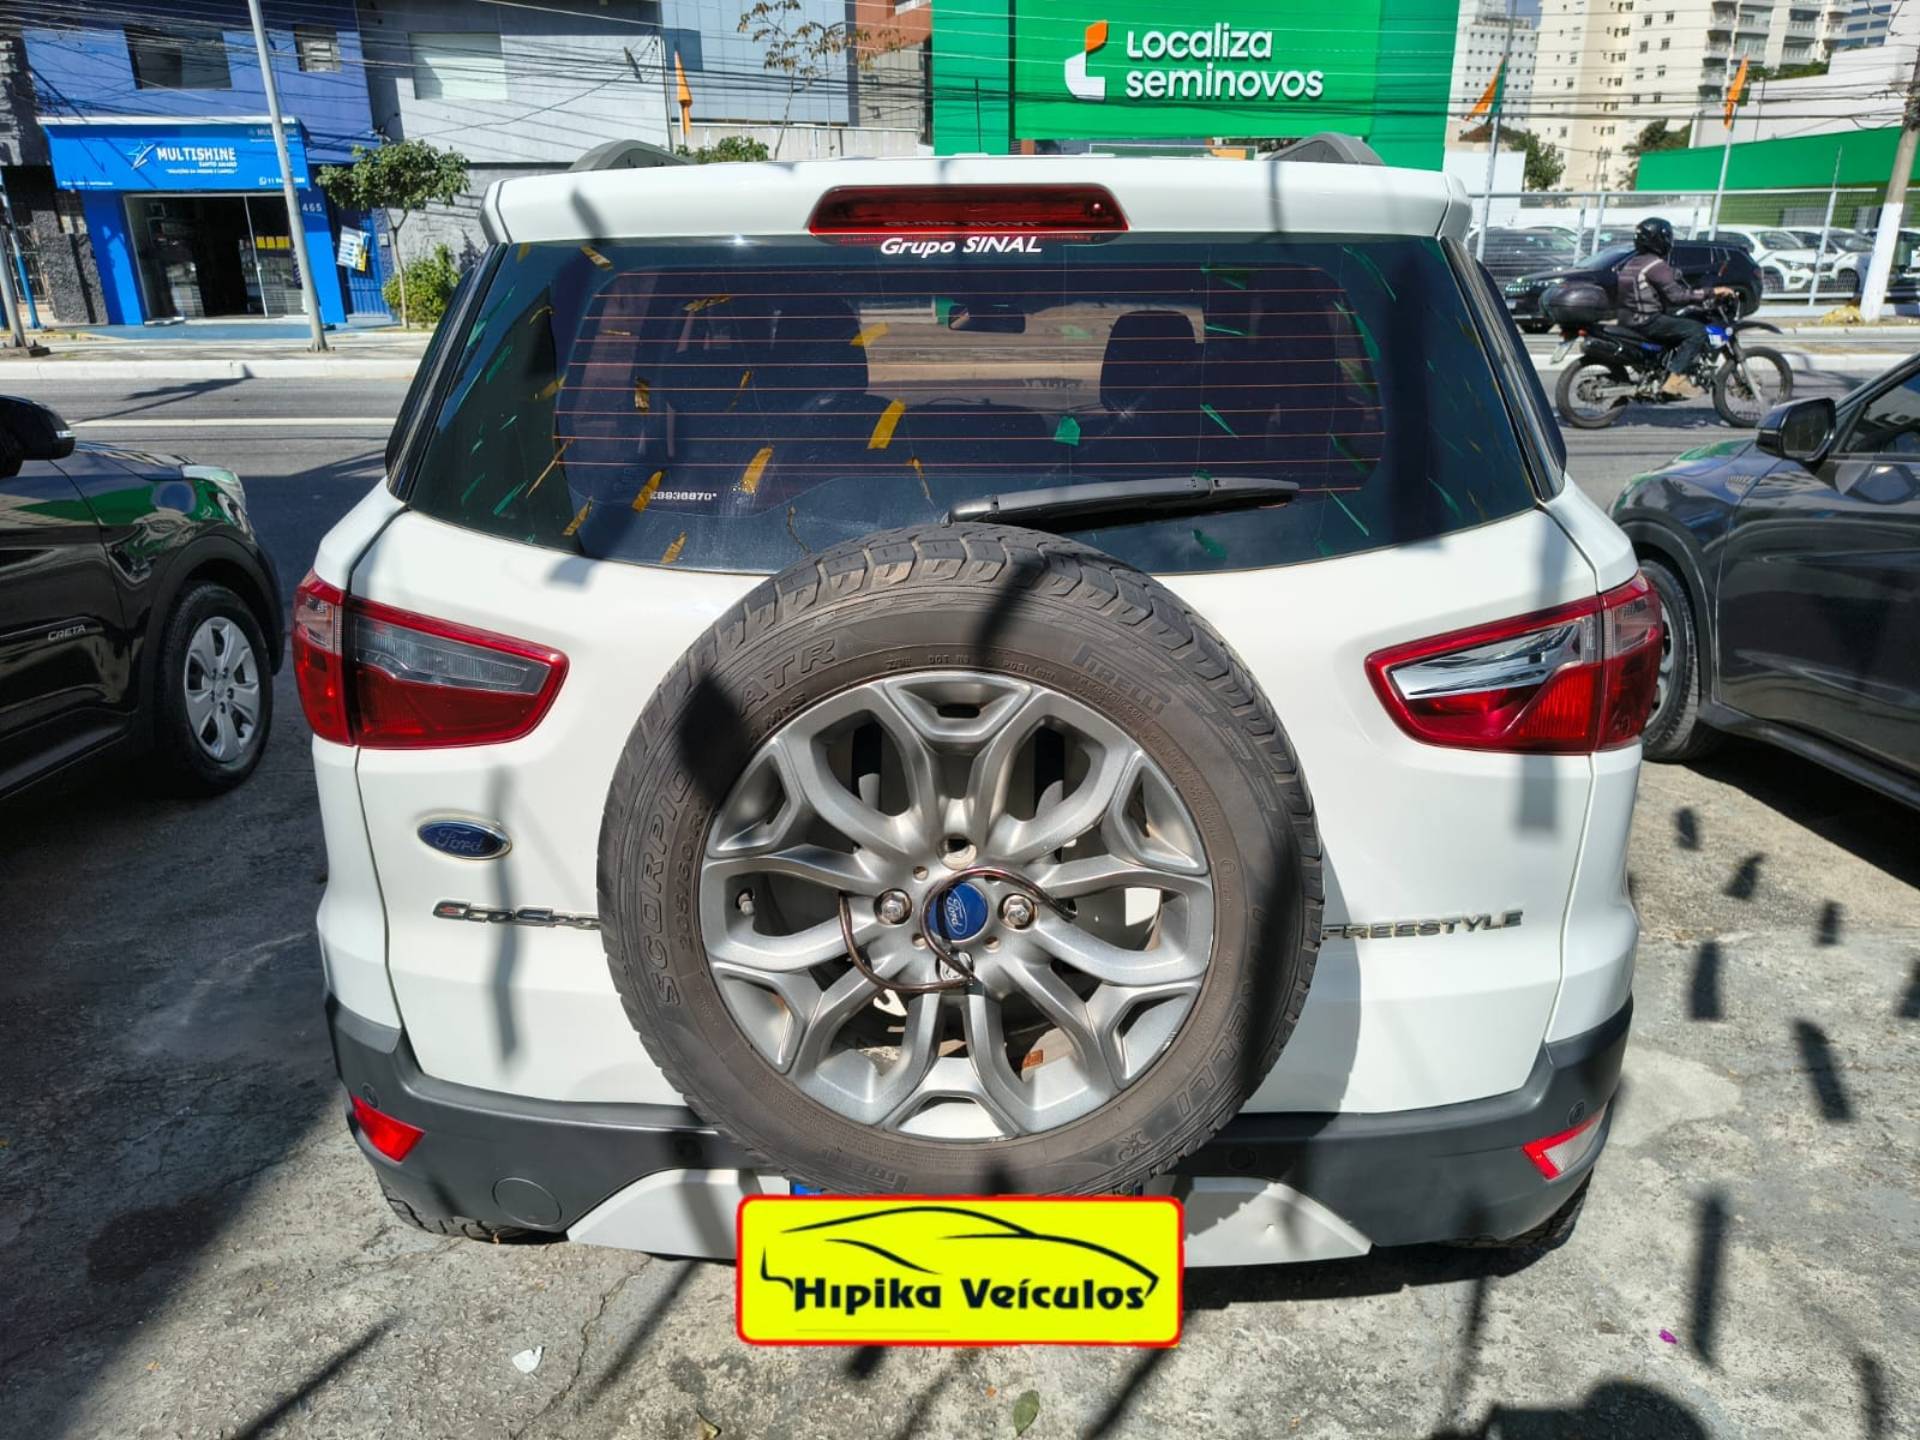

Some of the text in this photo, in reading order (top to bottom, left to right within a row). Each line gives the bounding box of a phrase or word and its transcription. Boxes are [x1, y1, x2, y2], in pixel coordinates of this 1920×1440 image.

[1127, 22, 1273, 58] Localiza
[1125, 62, 1324, 98] seminovos
[156, 146, 236, 161] MULTISHINE
[302, 202, 323, 213] 465
[880, 235, 1043, 258] Grupo SINAL
[47, 623, 87, 642] CRETA
[434, 828, 484, 852] Ford
